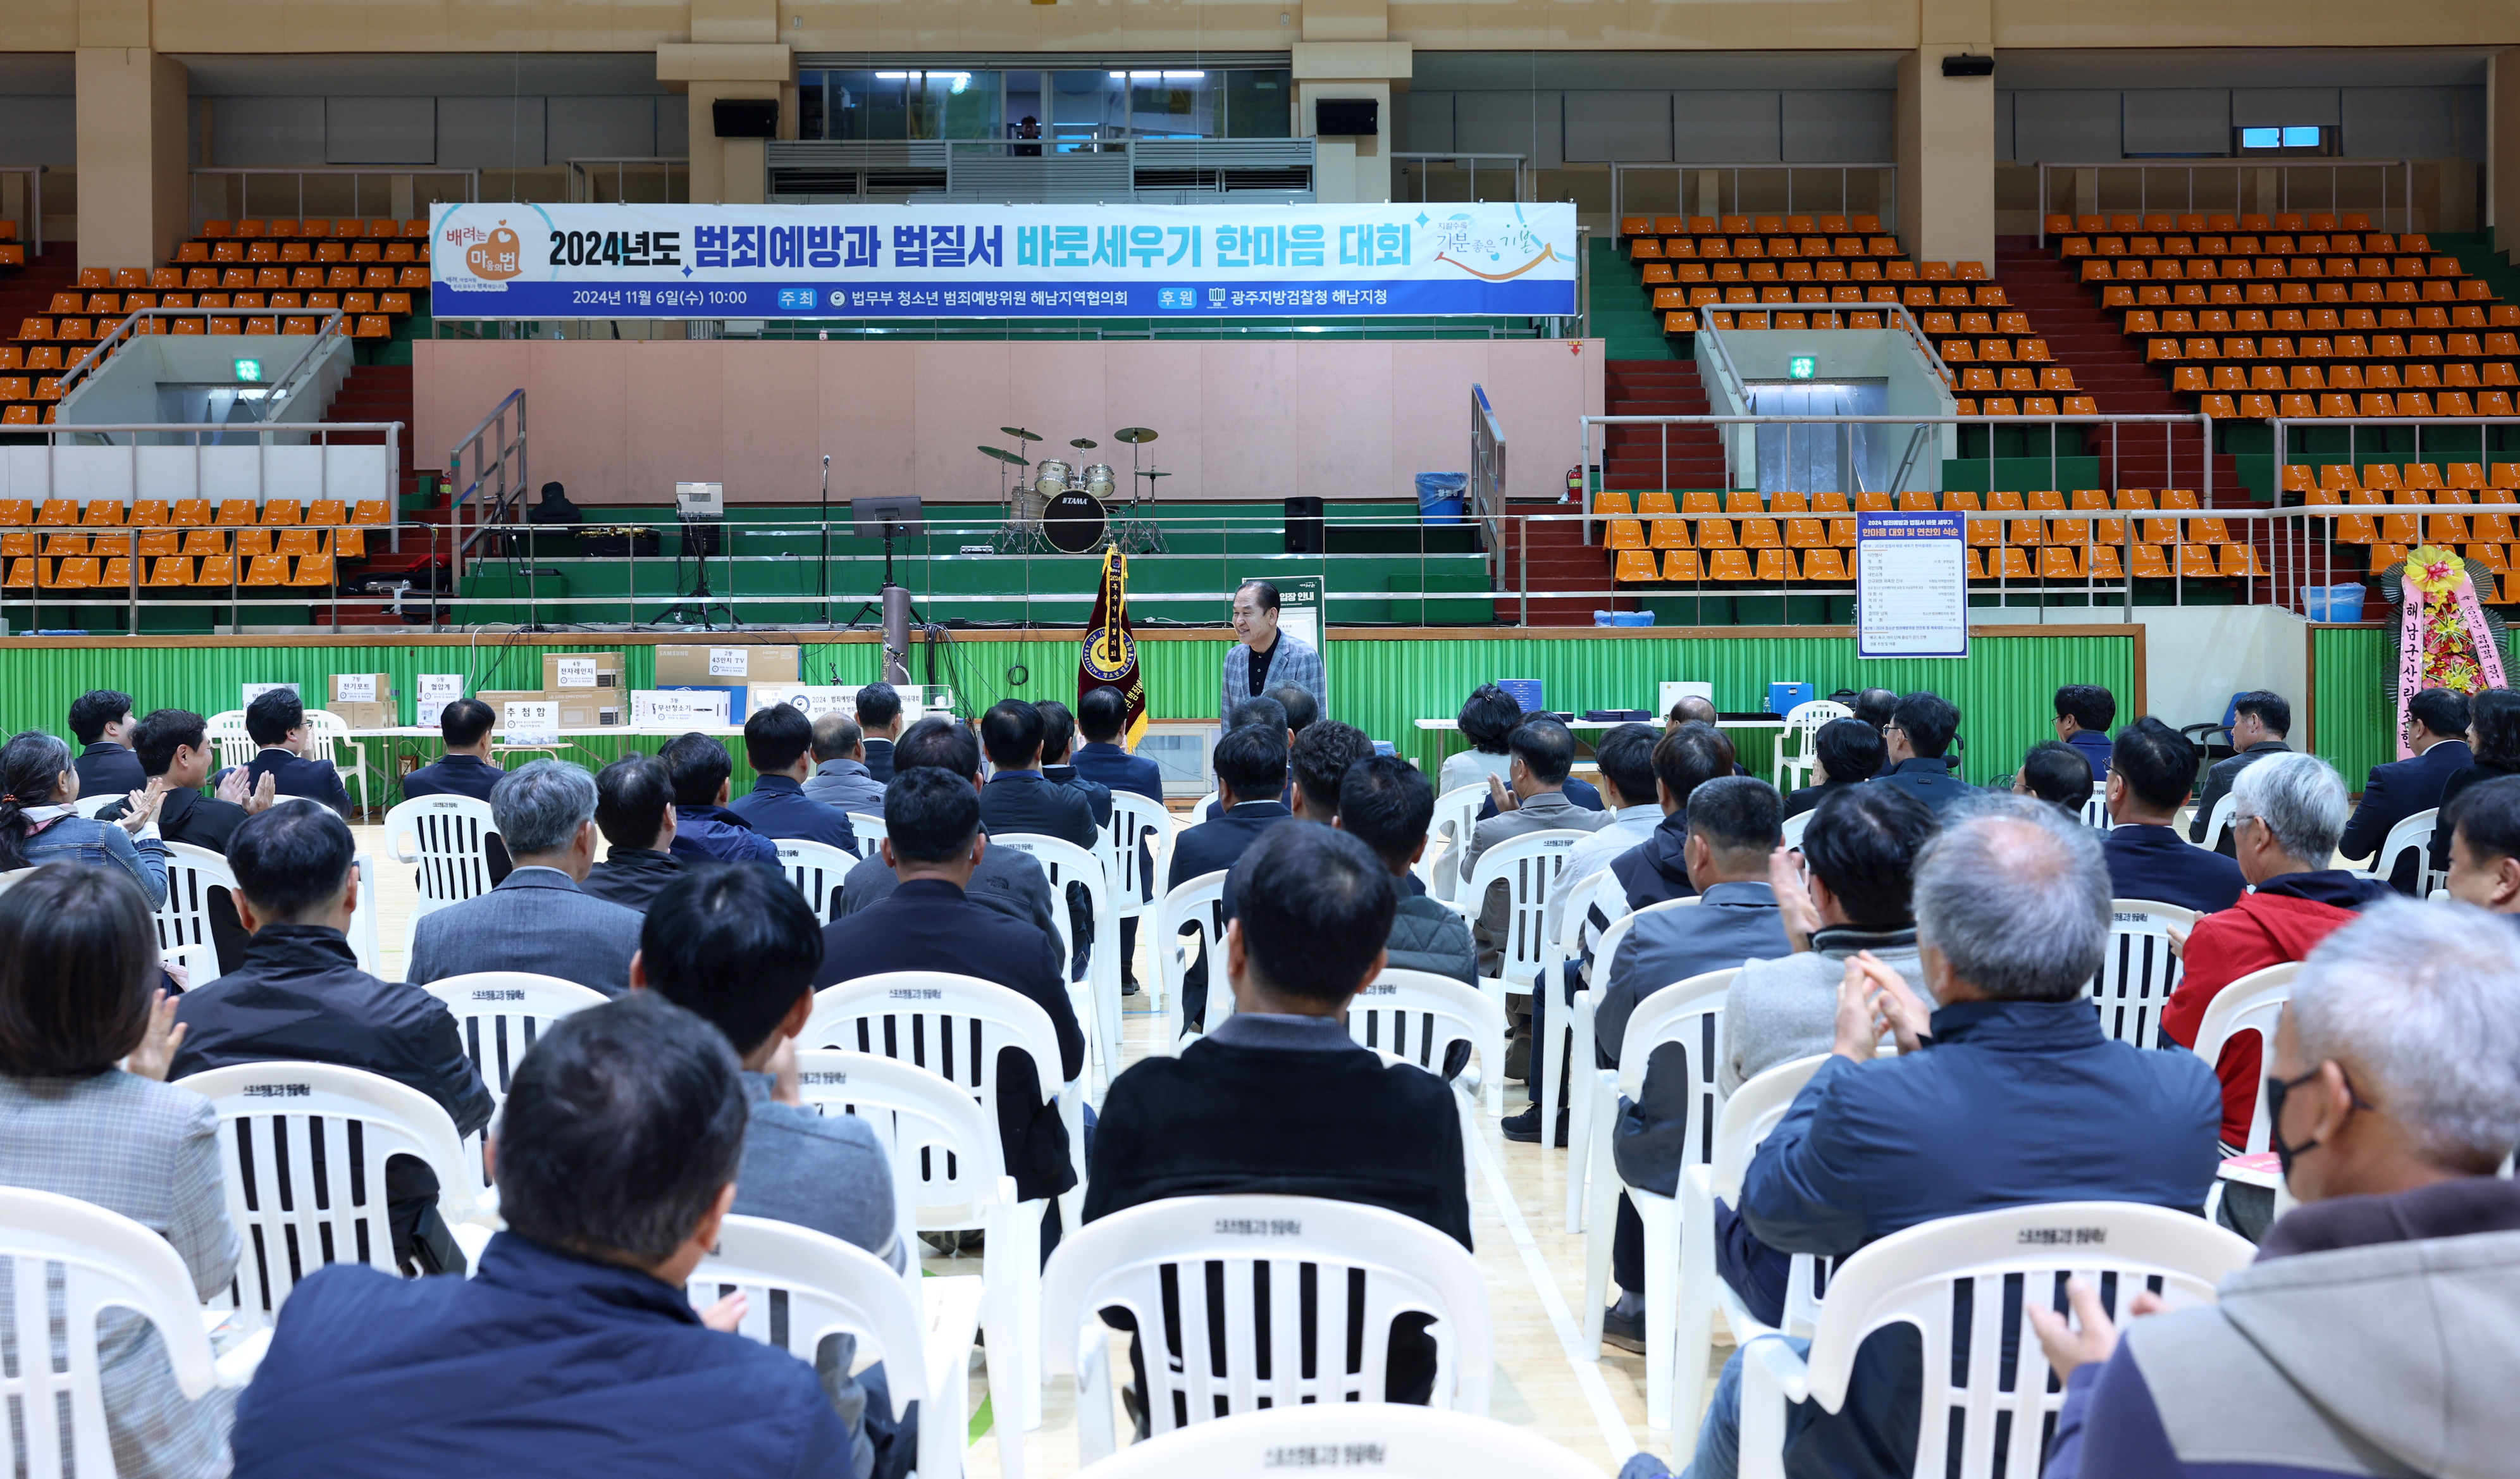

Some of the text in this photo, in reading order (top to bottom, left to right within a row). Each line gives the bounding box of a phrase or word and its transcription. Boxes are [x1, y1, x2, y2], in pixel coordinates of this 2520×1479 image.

[447, 226, 486, 246] 배려는
[1437, 230, 1534, 254] 기분 좋은 기본
[550, 223, 1411, 268] 2024년도 범죄예방과 법질서 바로세우기 한마음 대회
[573, 290, 747, 306] 2024년 11월 6일(수) 10:00
[852, 291, 893, 306] 법무부
[898, 291, 938, 306] 청소년
[944, 291, 1026, 306] 범죄예방위원
[1031, 291, 1127, 306] 해남지역협의회
[1231, 289, 1387, 306] 광주지방검찰청 해남지청
[1862, 528, 1959, 536] 한마음 대회 및 연찬회 식순
[1297, 591, 1314, 601] 안내
[1084, 634, 1099, 674] MINISTRY OF
